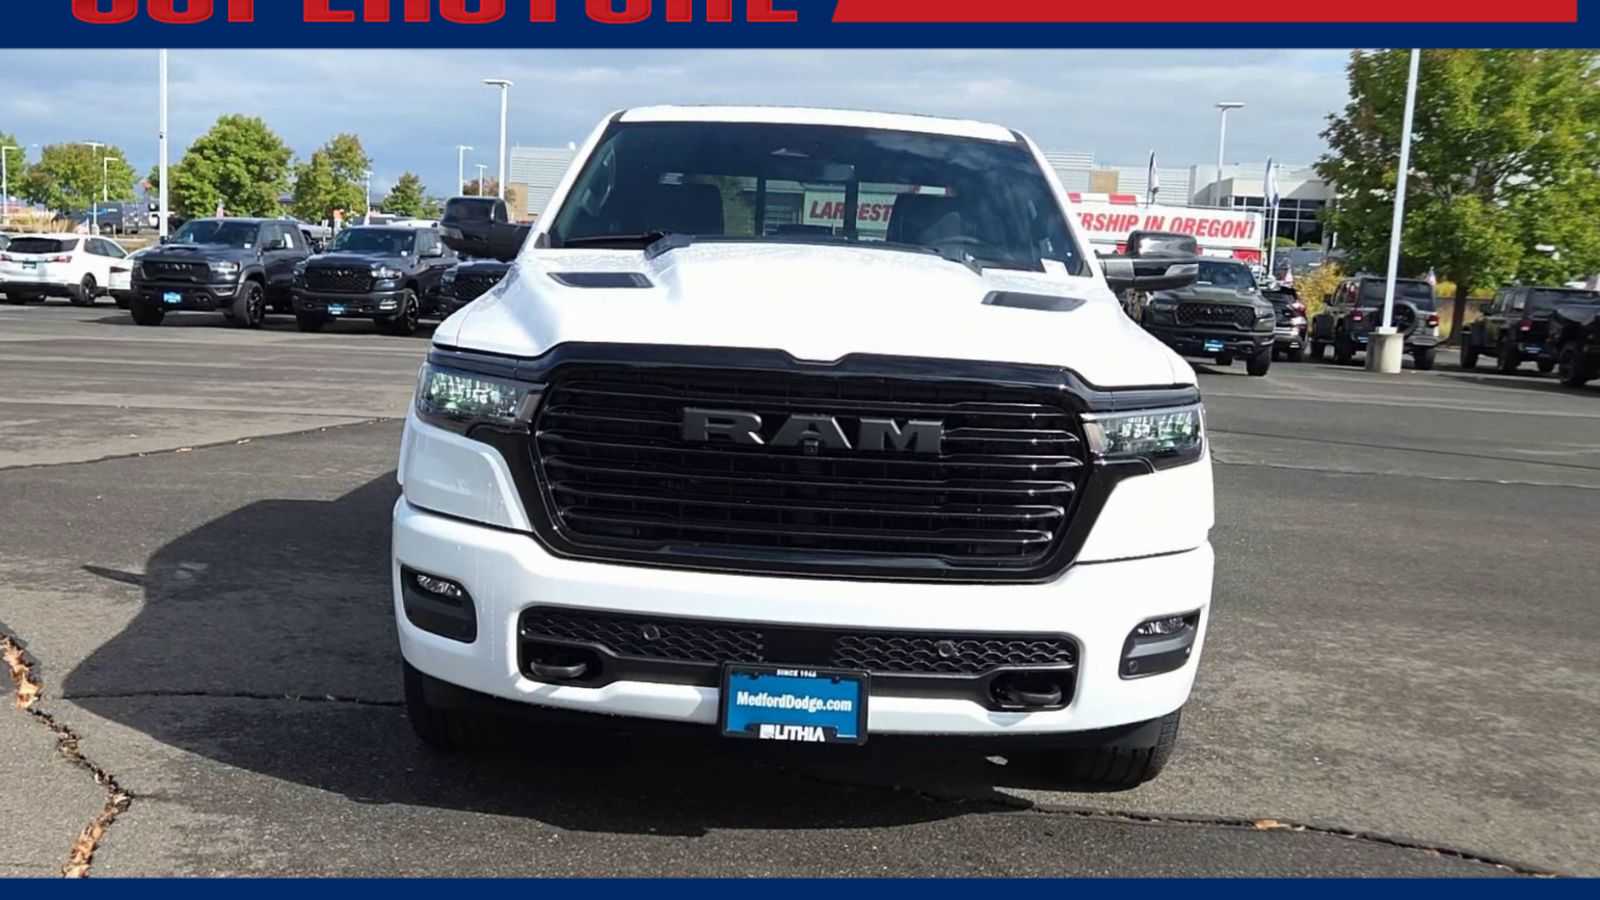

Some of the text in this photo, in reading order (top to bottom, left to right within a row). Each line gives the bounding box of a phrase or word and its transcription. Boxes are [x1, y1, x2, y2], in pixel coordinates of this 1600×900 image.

[809, 201, 893, 222] LAREST
[1077, 212, 1256, 239] RSHIP IN OREGON!
[683, 407, 944, 453] RAM
[776, 669, 798, 677] SINCE
[736, 691, 853, 713] MedfordDodge.com
[774, 724, 826, 742] LITHIA
